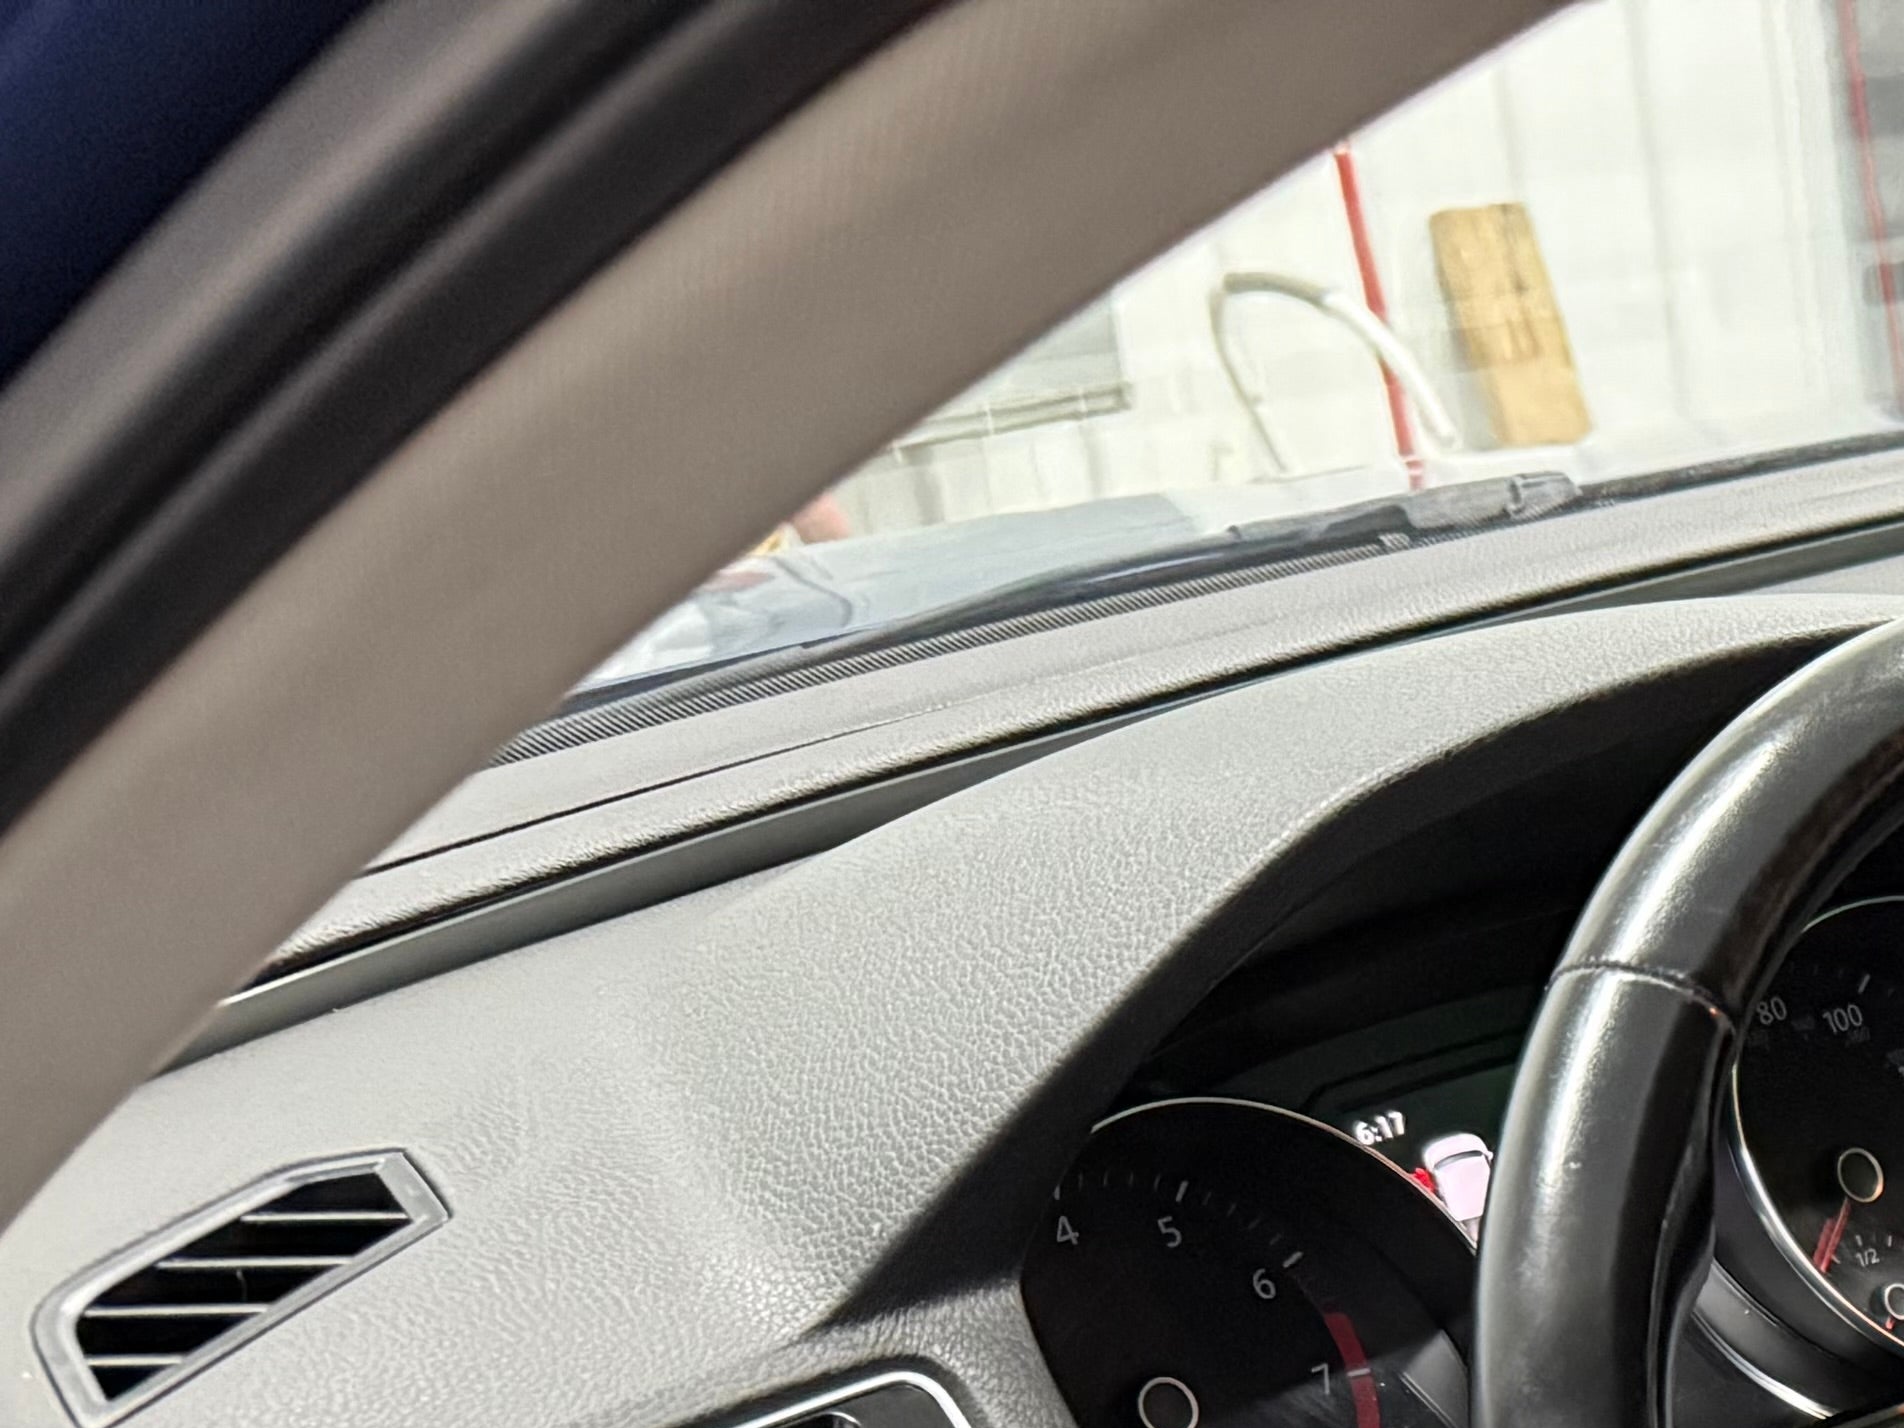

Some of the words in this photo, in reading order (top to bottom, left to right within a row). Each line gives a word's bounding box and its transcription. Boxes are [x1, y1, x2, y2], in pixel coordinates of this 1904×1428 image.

[1756, 995, 1788, 1026] 80
[1821, 1002, 1864, 1035] 100
[1355, 1109, 1405, 1146] 6:17
[1055, 1215, 1080, 1247] 4
[1157, 1216, 1183, 1249] 5
[1855, 1247, 1882, 1268] 1/2
[1252, 1267, 1277, 1300] 6
[1310, 1362, 1331, 1395] 7
